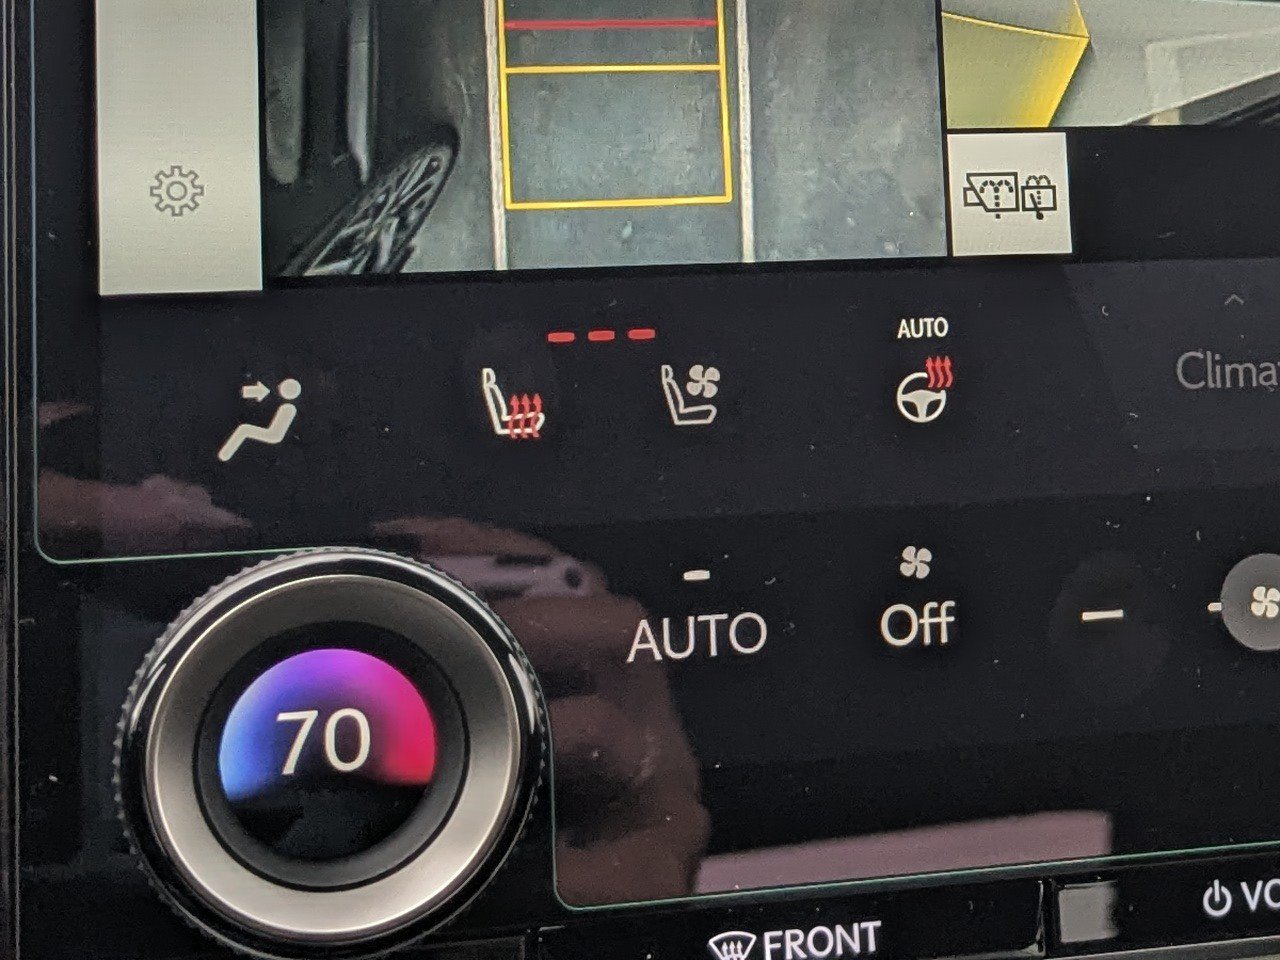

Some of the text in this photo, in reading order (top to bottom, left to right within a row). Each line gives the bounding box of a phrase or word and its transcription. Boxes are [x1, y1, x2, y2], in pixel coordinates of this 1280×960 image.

[897, 316, 949, 339] AUTO
[626, 611, 768, 663] AUTO
[880, 600, 956, 647] Off
[276, 707, 371, 775] 70
[763, 920, 882, 960] FRONT
